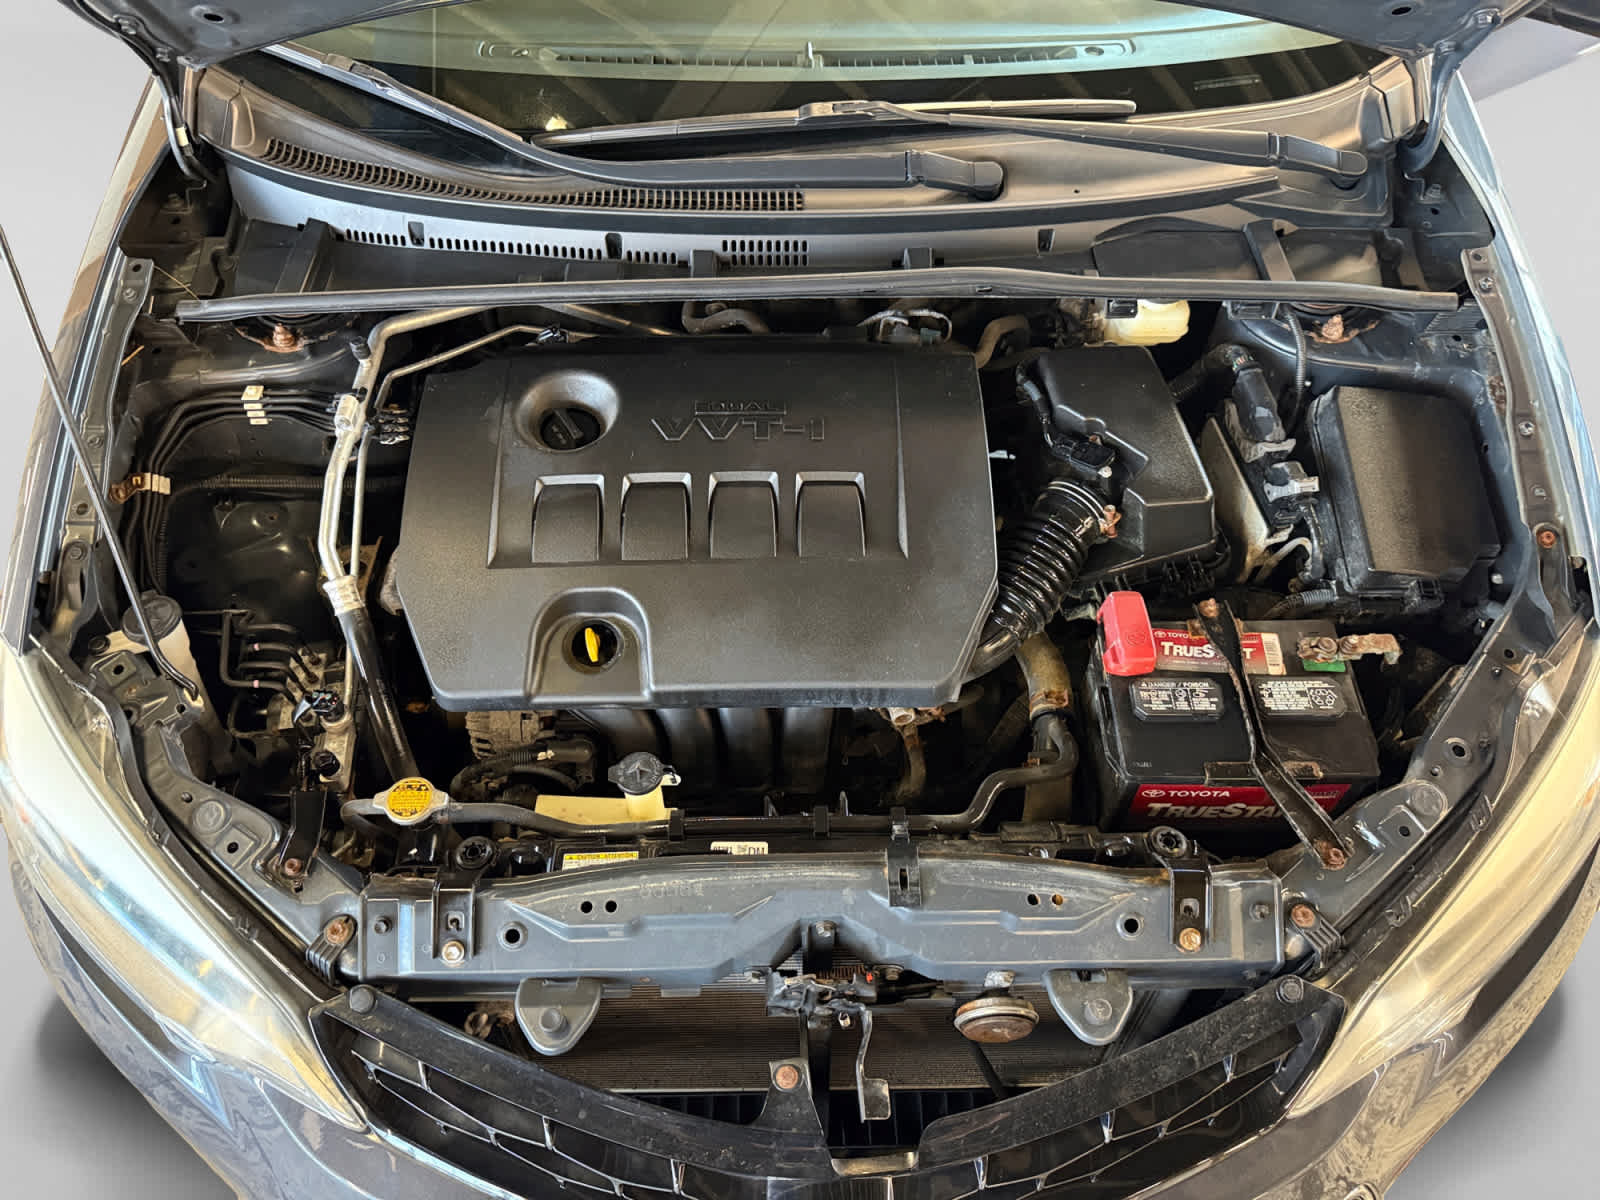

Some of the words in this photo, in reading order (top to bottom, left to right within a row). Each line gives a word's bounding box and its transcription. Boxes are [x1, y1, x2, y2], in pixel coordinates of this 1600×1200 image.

[1160, 641, 1256, 660] TRUEST
[1168, 790, 1230, 798] TOYOTA
[1147, 802, 1283, 819] TRUESTA
